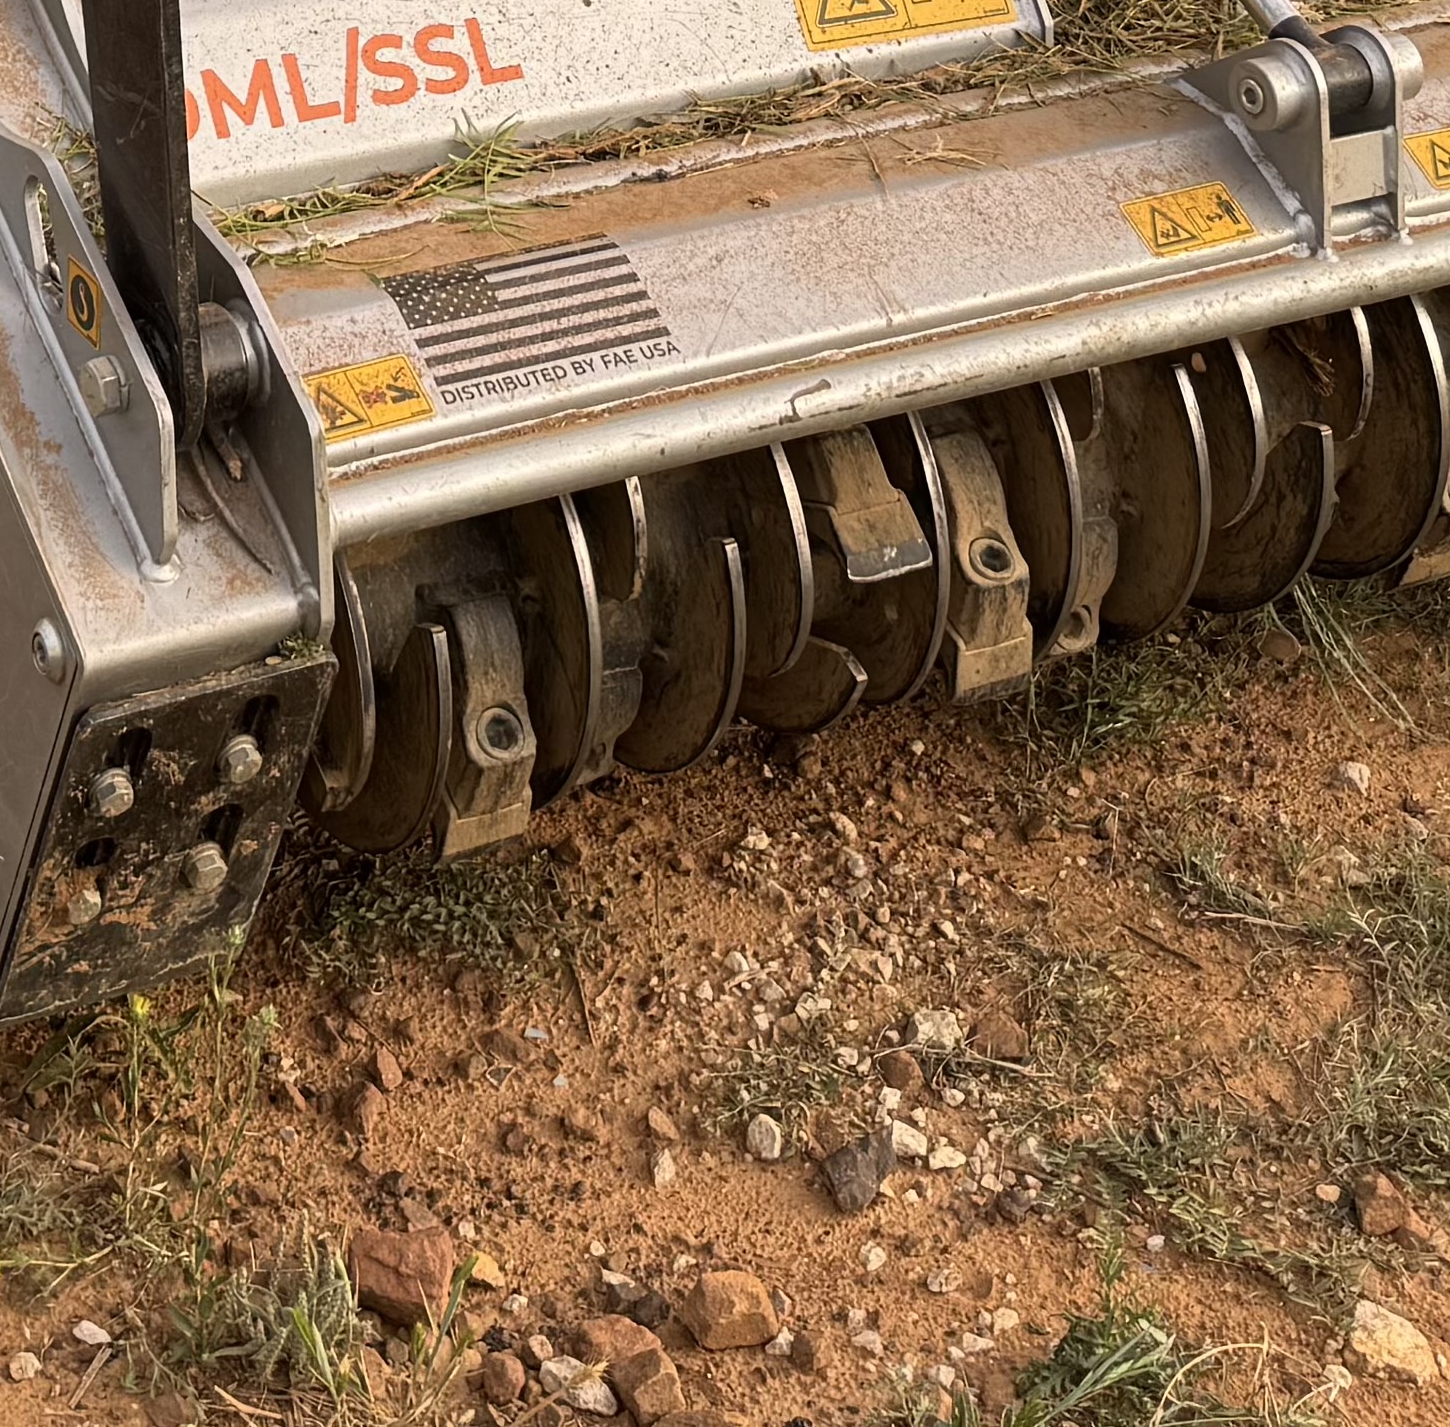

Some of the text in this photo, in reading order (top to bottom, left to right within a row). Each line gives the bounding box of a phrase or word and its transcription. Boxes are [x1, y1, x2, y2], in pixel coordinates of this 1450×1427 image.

[440, 340, 681, 406] DISTRIBUTED BY FAE USA
